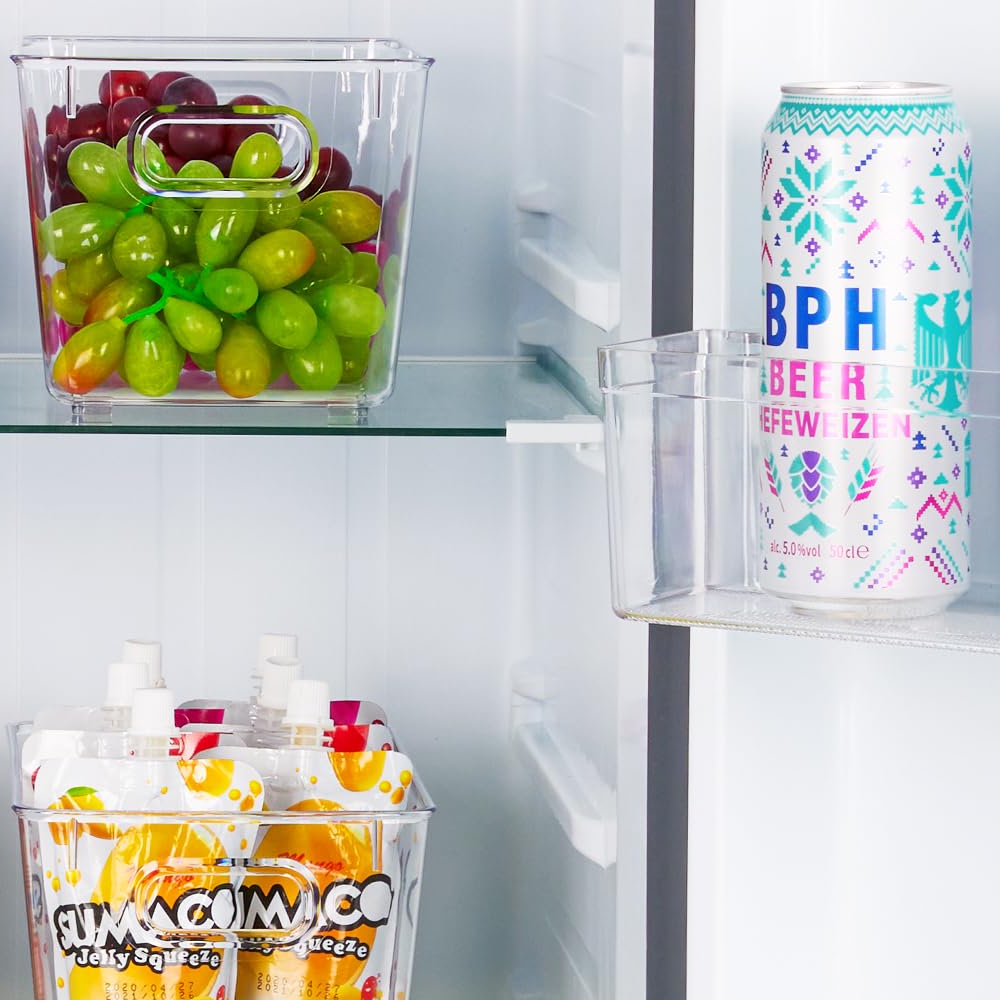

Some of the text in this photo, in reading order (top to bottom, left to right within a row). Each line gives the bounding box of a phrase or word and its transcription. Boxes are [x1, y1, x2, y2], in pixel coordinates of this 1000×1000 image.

[766, 283, 887, 351] BPH
[769, 359, 866, 400] BEER
[761, 406, 911, 438] EFEWEIZEN
[76, 948, 221, 974] Jelly Squeeze
